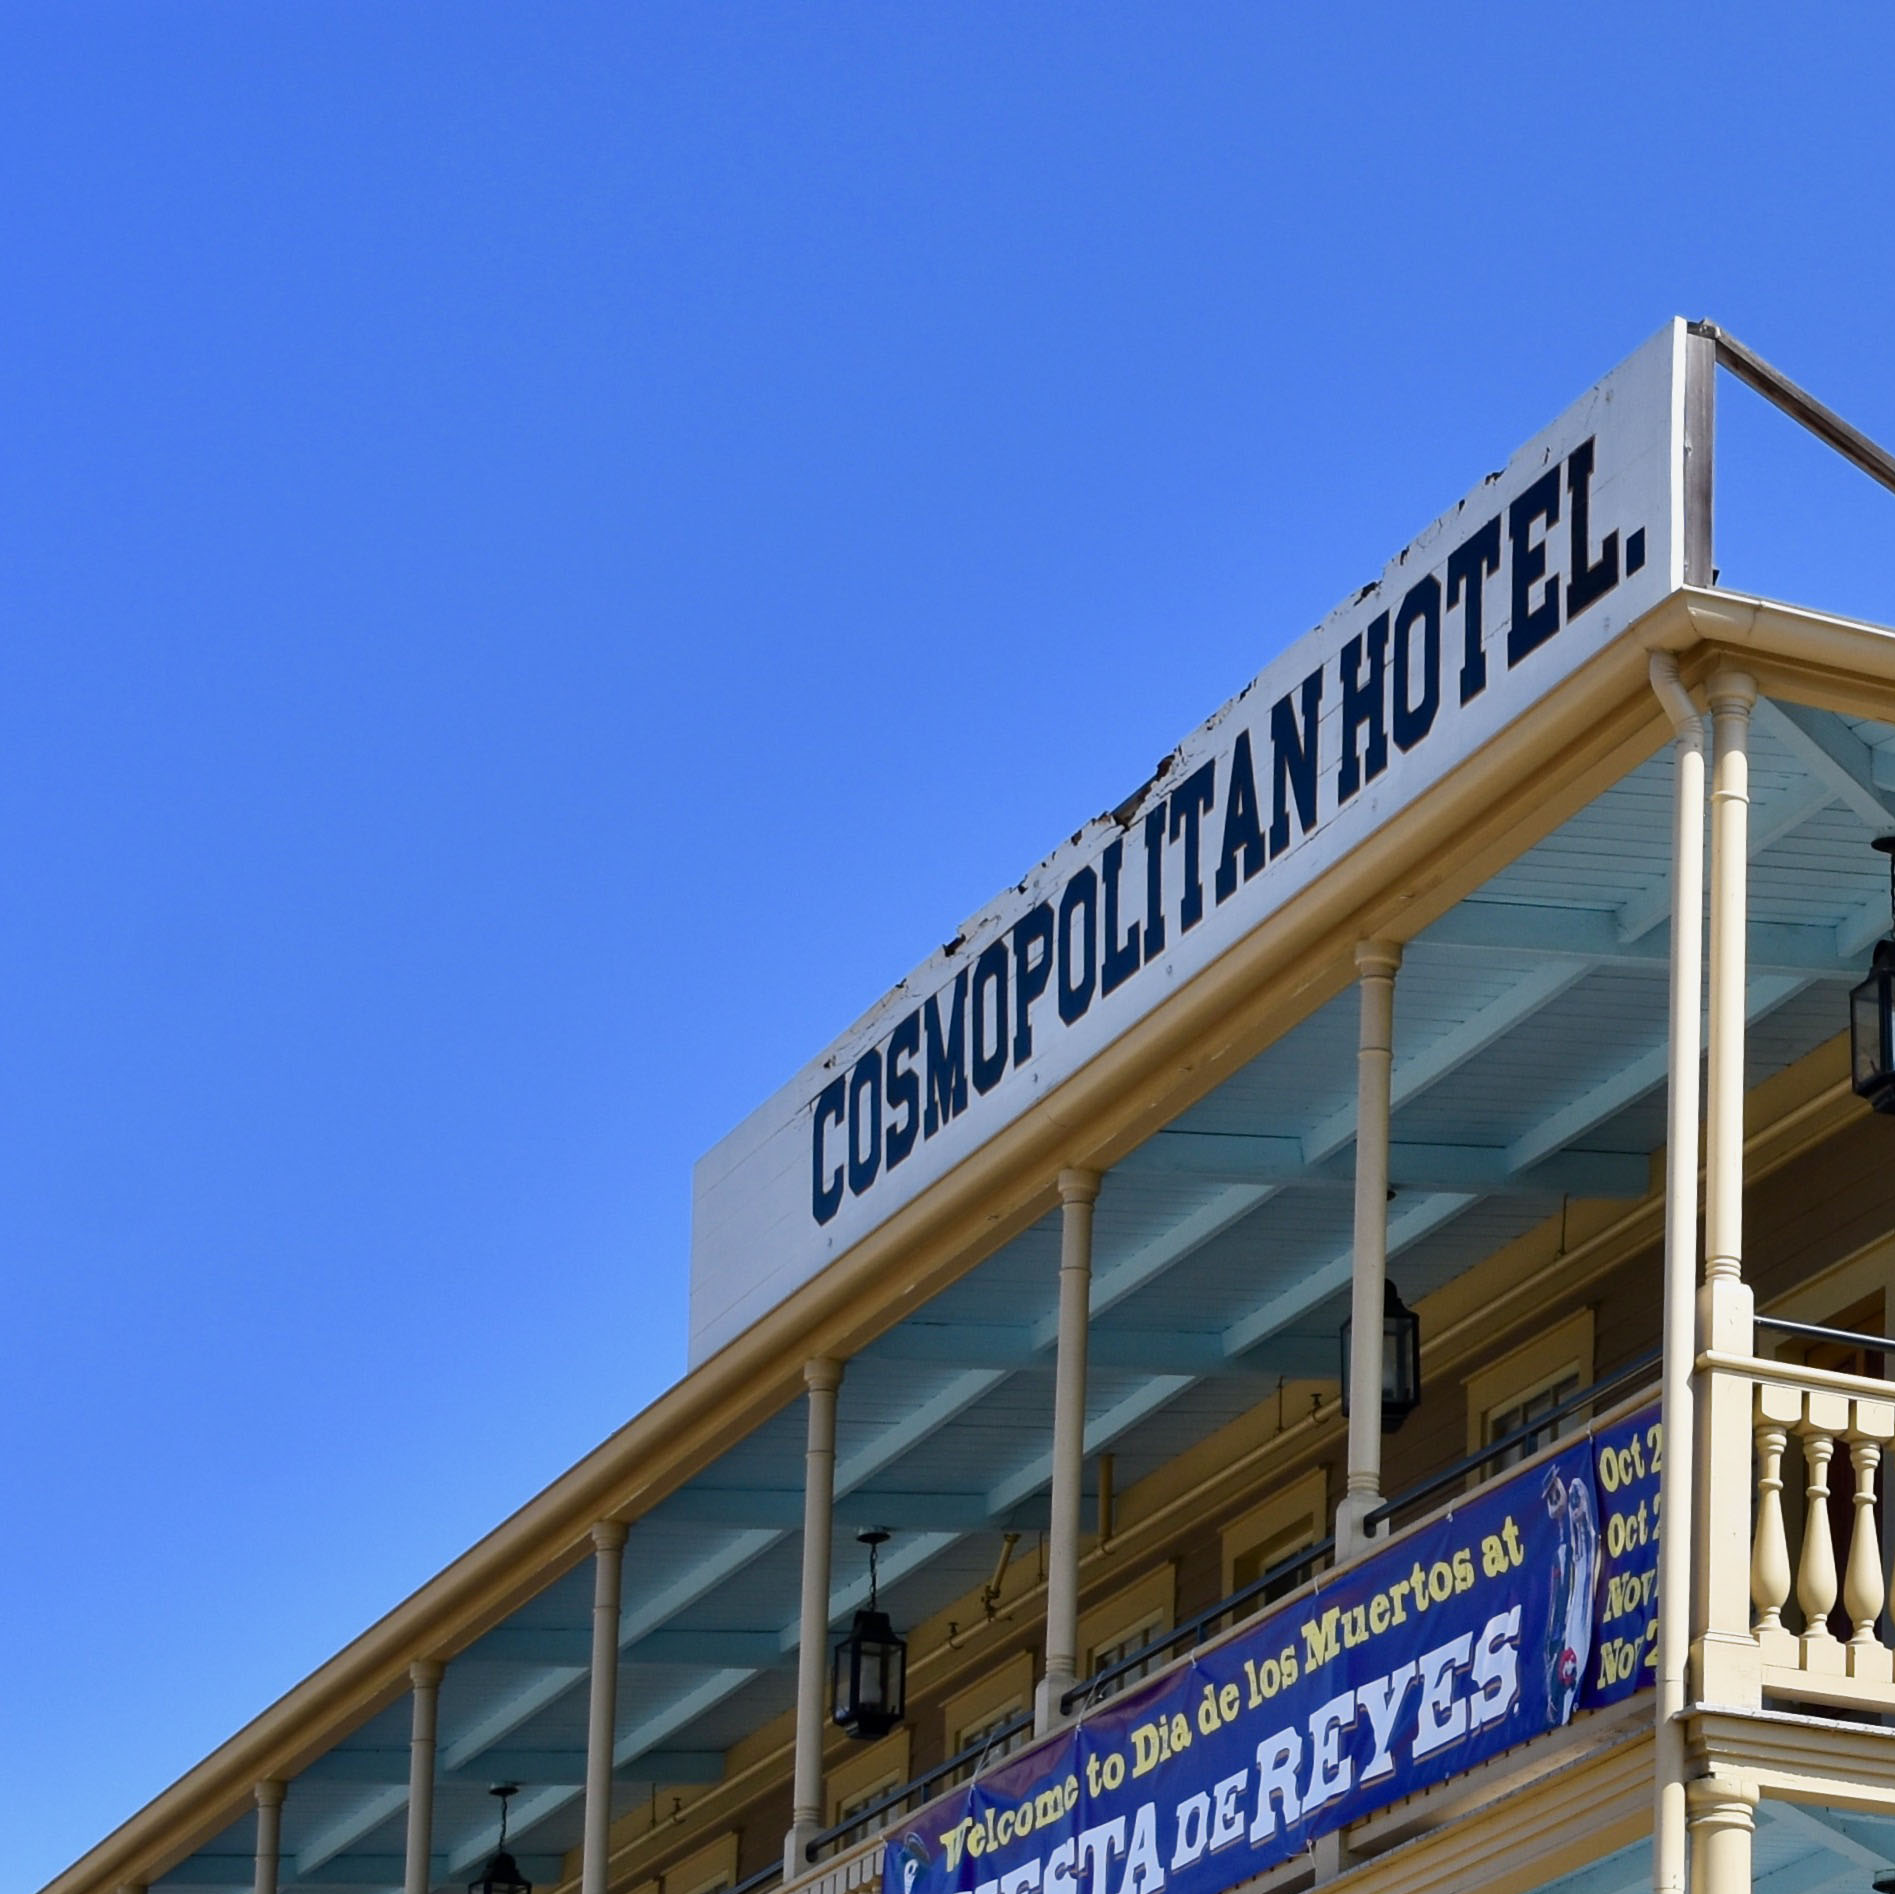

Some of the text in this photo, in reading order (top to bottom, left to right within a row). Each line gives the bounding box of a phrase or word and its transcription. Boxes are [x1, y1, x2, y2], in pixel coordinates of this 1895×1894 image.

[811, 436, 1647, 1227] COSMOPOLITAN HOTEL.
[1600, 1433, 1645, 1493] Oct
[1608, 1499, 1648, 1558] Oct
[1603, 1569, 1656, 1624] Nov
[1597, 1635, 1645, 1690] Nov
[940, 1515, 1525, 1873] Welcome to Dia de los Muertos at
[1171, 1768, 1247, 1871] DE
